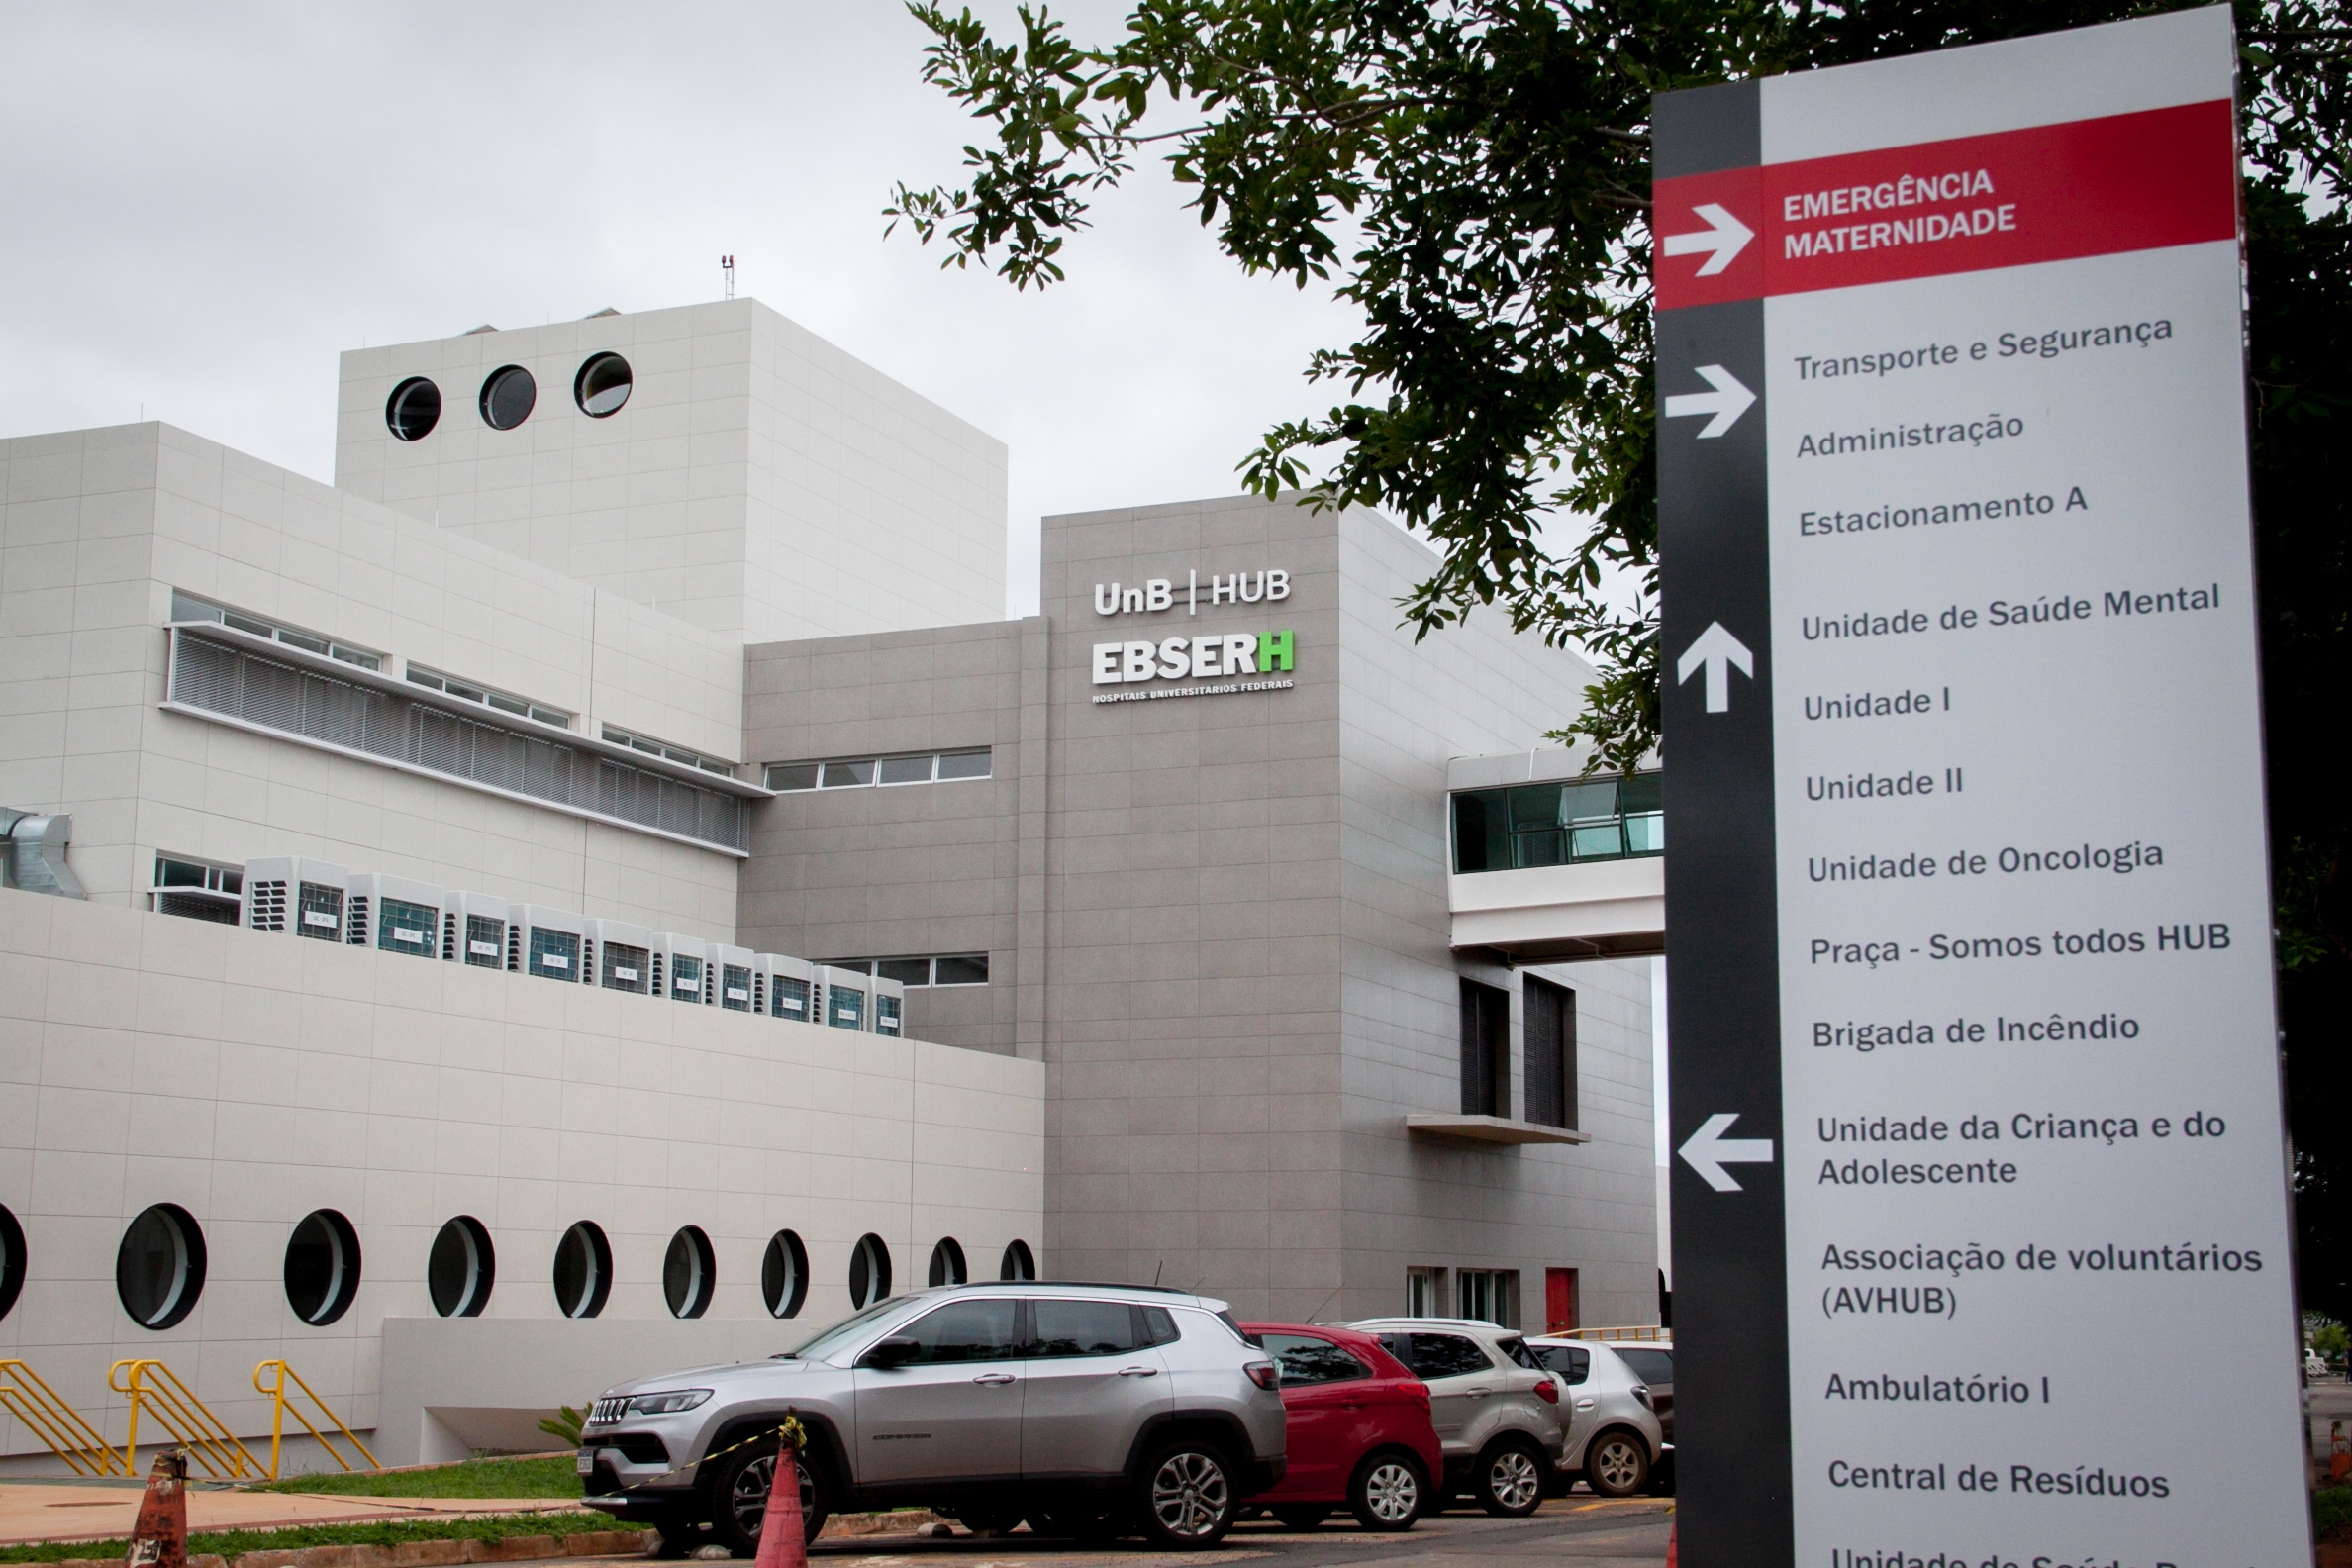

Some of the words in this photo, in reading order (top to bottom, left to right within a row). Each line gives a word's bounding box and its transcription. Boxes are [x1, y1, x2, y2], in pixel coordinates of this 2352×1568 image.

[1784, 169, 1994, 222] EMERGÊNCIA
[1785, 203, 2016, 260] MATERNIDADE
[1794, 343, 1958, 380] Transporte
[1969, 342, 1988, 361] e
[1998, 319, 2173, 359] Segurança
[1797, 413, 2024, 458] Administração
[1800, 492, 2055, 537] Estacionamento
[2065, 485, 2089, 512] A
[1094, 578, 1174, 616] UnB
[1212, 569, 1291, 605] HUB
[1803, 609, 1928, 640] Unidade
[1939, 605, 1978, 631] de
[1989, 595, 2092, 627] Saúde
[2104, 582, 2219, 617] Mental
[1092, 629, 1295, 684] EBSERH
[1092, 690, 1147, 704] HOSPITAIS
[1240, 678, 1295, 692] FEDERAIS
[1805, 689, 1931, 721] Unidade
[1943, 686, 1950, 712] I
[1806, 770, 1934, 801] Unidade
[1945, 767, 1963, 793] II
[1809, 852, 1937, 883] Unidade
[1947, 849, 1987, 876] de
[1998, 840, 2164, 874] Oncologia
[1811, 938, 1900, 969] Praça
[1929, 933, 2042, 960] Somos
[2052, 928, 2146, 955] todos
[2157, 923, 2231, 951] HUB
[1813, 1019, 1934, 1052] Brigada
[1946, 1018, 1986, 1044] de
[1997, 1013, 2140, 1042] Incêndio
[1817, 1115, 1949, 1143] Unidade
[1960, 1114, 2000, 1140] da
[2011, 1112, 2139, 1146] Criança
[2151, 1117, 2171, 1138] e
[2183, 1110, 2226, 1138] do
[1817, 1158, 2017, 1185] Adolescente
[1821, 1242, 2005, 1278] Associação
[2015, 1243, 2057, 1271] de
[2067, 1241, 2263, 1273] voluntários
[1822, 1287, 1957, 1320] (AVHUB)
[1824, 1373, 2030, 1404] Ambulatório
[2041, 1376, 2050, 1404] I
[1828, 1460, 1945, 1491] Central
[1957, 1464, 1999, 1493] de
[2010, 1464, 2170, 1499] Resíduos
